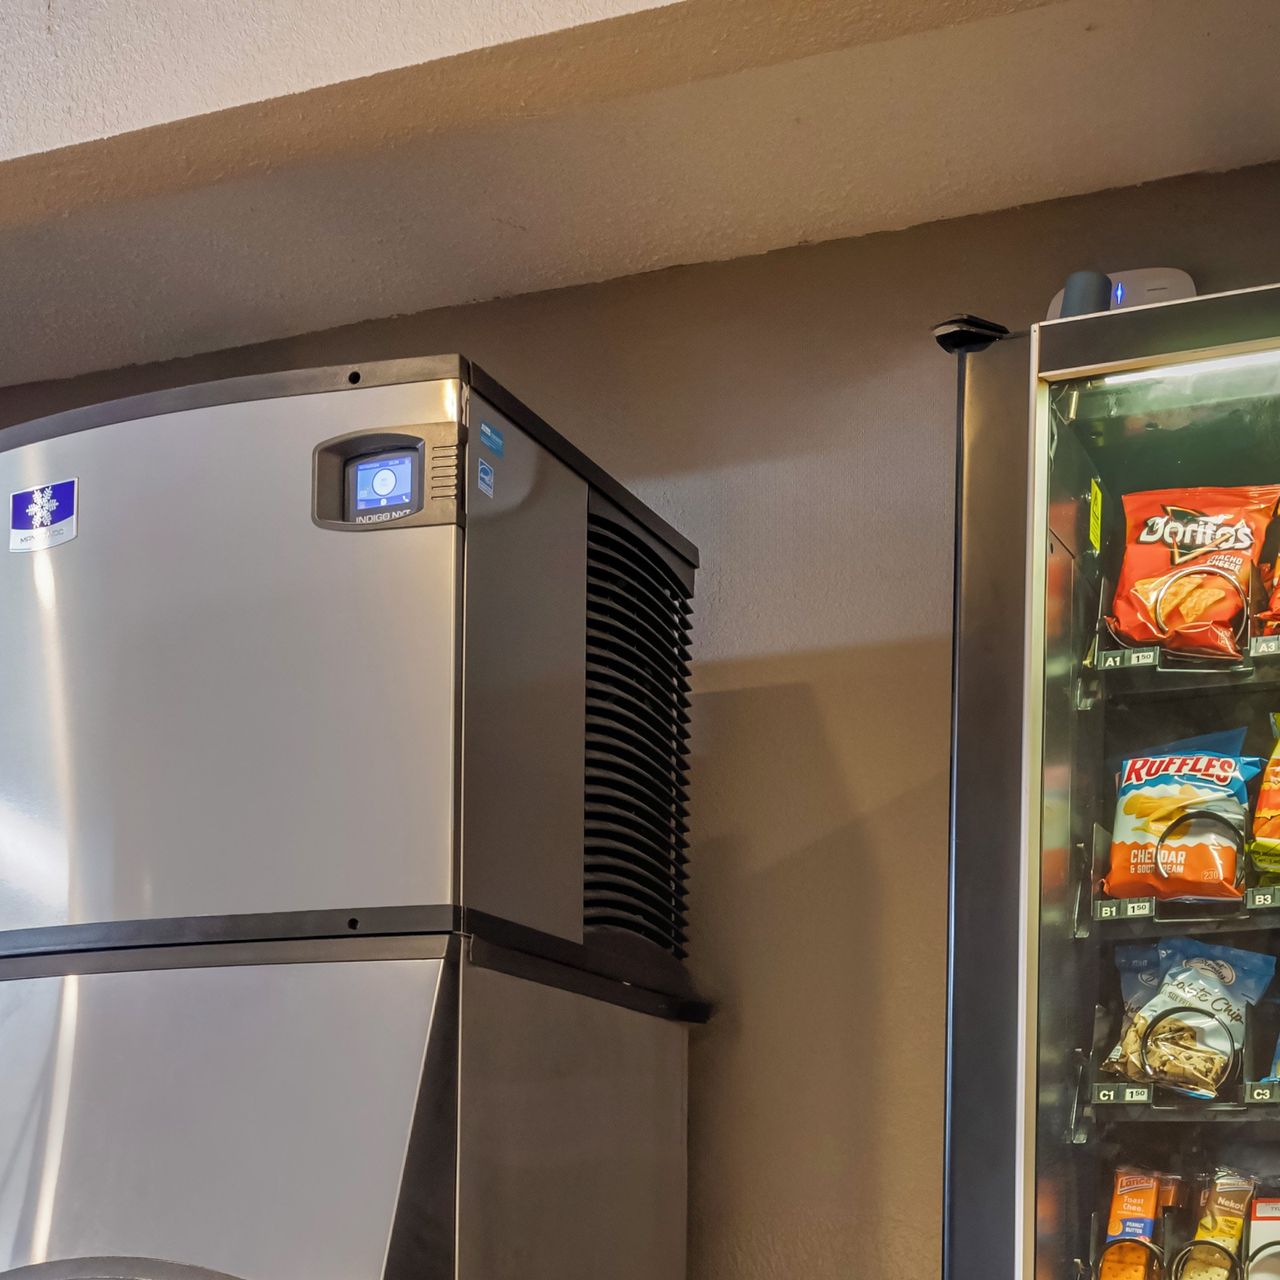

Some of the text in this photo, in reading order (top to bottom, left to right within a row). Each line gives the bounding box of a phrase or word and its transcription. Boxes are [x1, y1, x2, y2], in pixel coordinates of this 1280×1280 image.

[356, 508, 412, 524] INDIGO NXT
[1139, 514, 1256, 550] Doritos
[1259, 643, 1276, 653] A3
[1105, 656, 1121, 666] A1
[1124, 756, 1237, 786] RUFFLES
[1255, 894, 1272, 905] B3
[1101, 906, 1117, 917] B1
[1211, 997, 1244, 1024] Chip
[1099, 1090, 1115, 1100] C1
[1253, 1089, 1270, 1099] C3
[1123, 1195, 1144, 1205] Toast
[1217, 1196, 1244, 1211] Nekot
[1126, 1221, 1145, 1229] PEANUT
